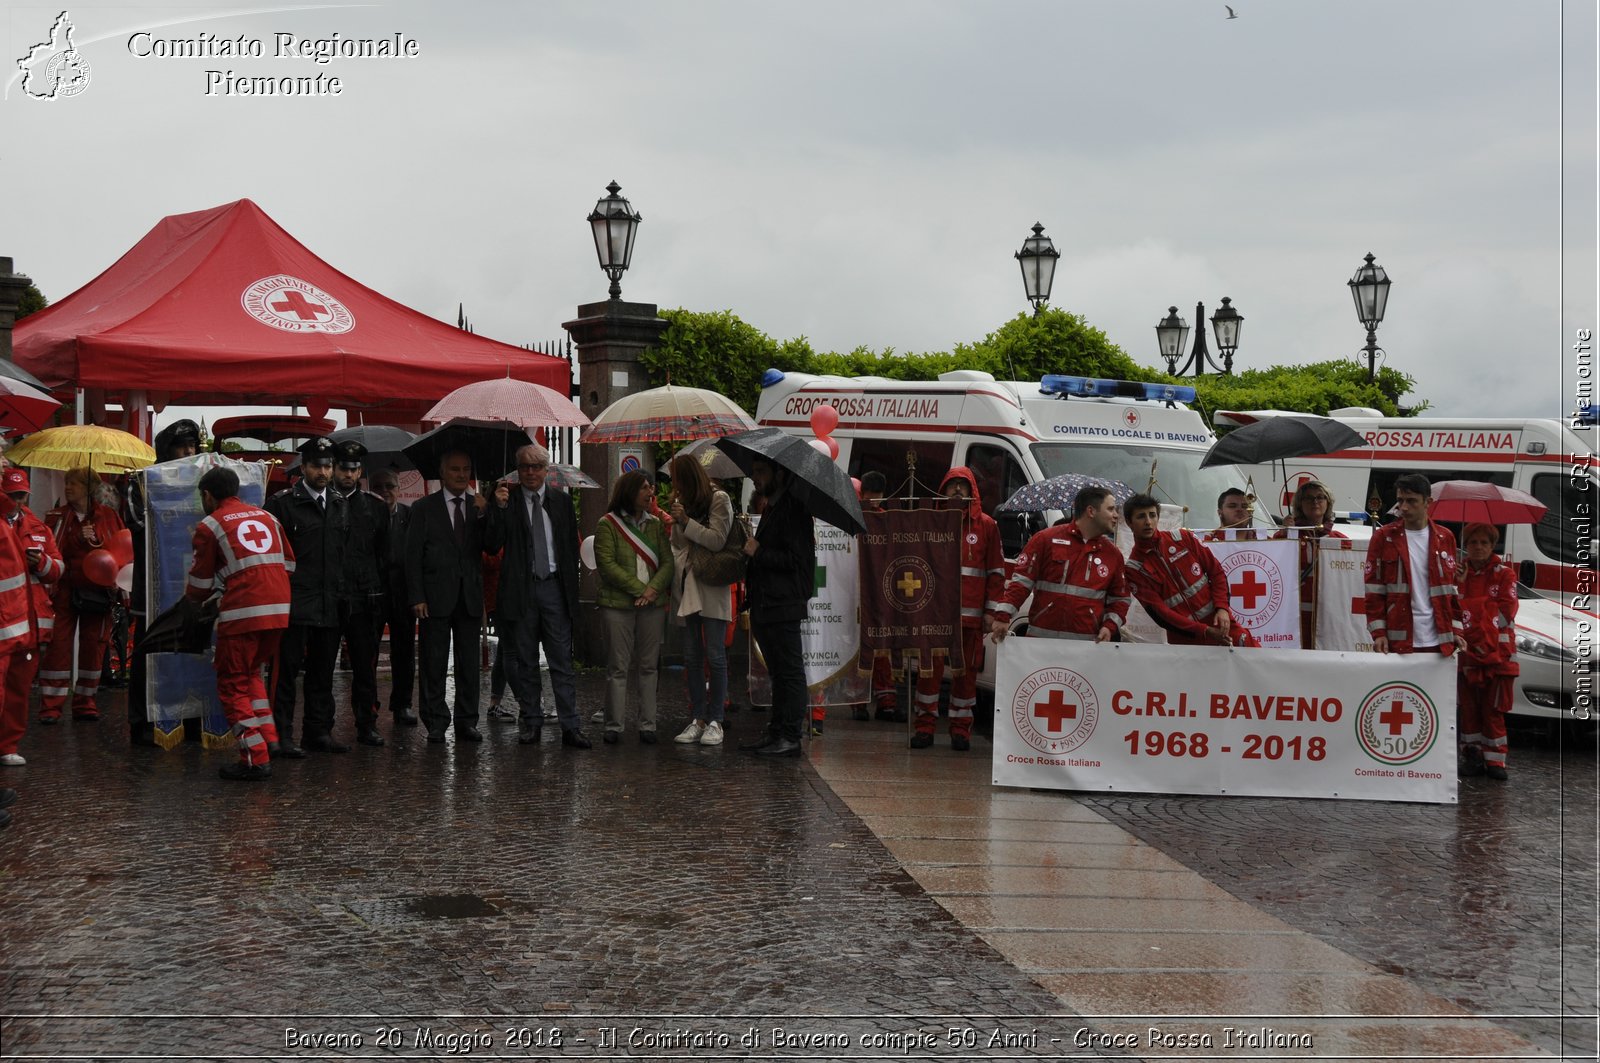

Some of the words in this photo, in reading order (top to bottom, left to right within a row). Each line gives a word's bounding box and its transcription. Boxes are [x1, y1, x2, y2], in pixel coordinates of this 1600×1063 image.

[262, 277, 314, 294] GINEVRA
[831, 398, 873, 417] ROSSA
[876, 398, 939, 418] ITALIANA
[1053, 425, 1108, 436] COMITATO
[1112, 428, 1152, 439] LOCALE
[1154, 432, 1165, 440] DI
[1168, 433, 1206, 443] BAVENO
[1365, 431, 1424, 447] ROSSA
[1428, 432, 1514, 449] ITALIANA
[862, 534, 888, 545] CROCE
[892, 532, 920, 543] ROSSA
[922, 531, 955, 543] ITALIANA
[814, 543, 847, 551] SISTENZA
[1231, 553, 1267, 568] GINEVRA
[1330, 560, 1355, 570] CROCE
[1268, 567, 1278, 577] 22
[1268, 579, 1281, 612] AGOSTO
[810, 602, 832, 610] VERDE
[823, 615, 842, 623] TOCE
[1264, 633, 1294, 642] Italiana
[1355, 643, 1373, 652] COM
[1027, 677, 1040, 690] DI
[1040, 671, 1082, 691] GINEVRA
[1081, 689, 1092, 700] 22
[1111, 690, 1197, 718] C.R.I.
[1209, 693, 1343, 723] BAVENO
[1016, 687, 1048, 749] CONVENZIONE
[1077, 702, 1096, 739] AGOSTO
[1124, 730, 1209, 758] 1968
[1241, 734, 1327, 761] 2018
[1383, 737, 1407, 755] 50
[1007, 754, 1034, 764] Croce
[1037, 756, 1066, 766] Rossa
[1068, 758, 1101, 767] Italiana
[1354, 768, 1394, 777] Comitato
[1397, 769, 1405, 778] di
[1407, 770, 1442, 780] Baveno
